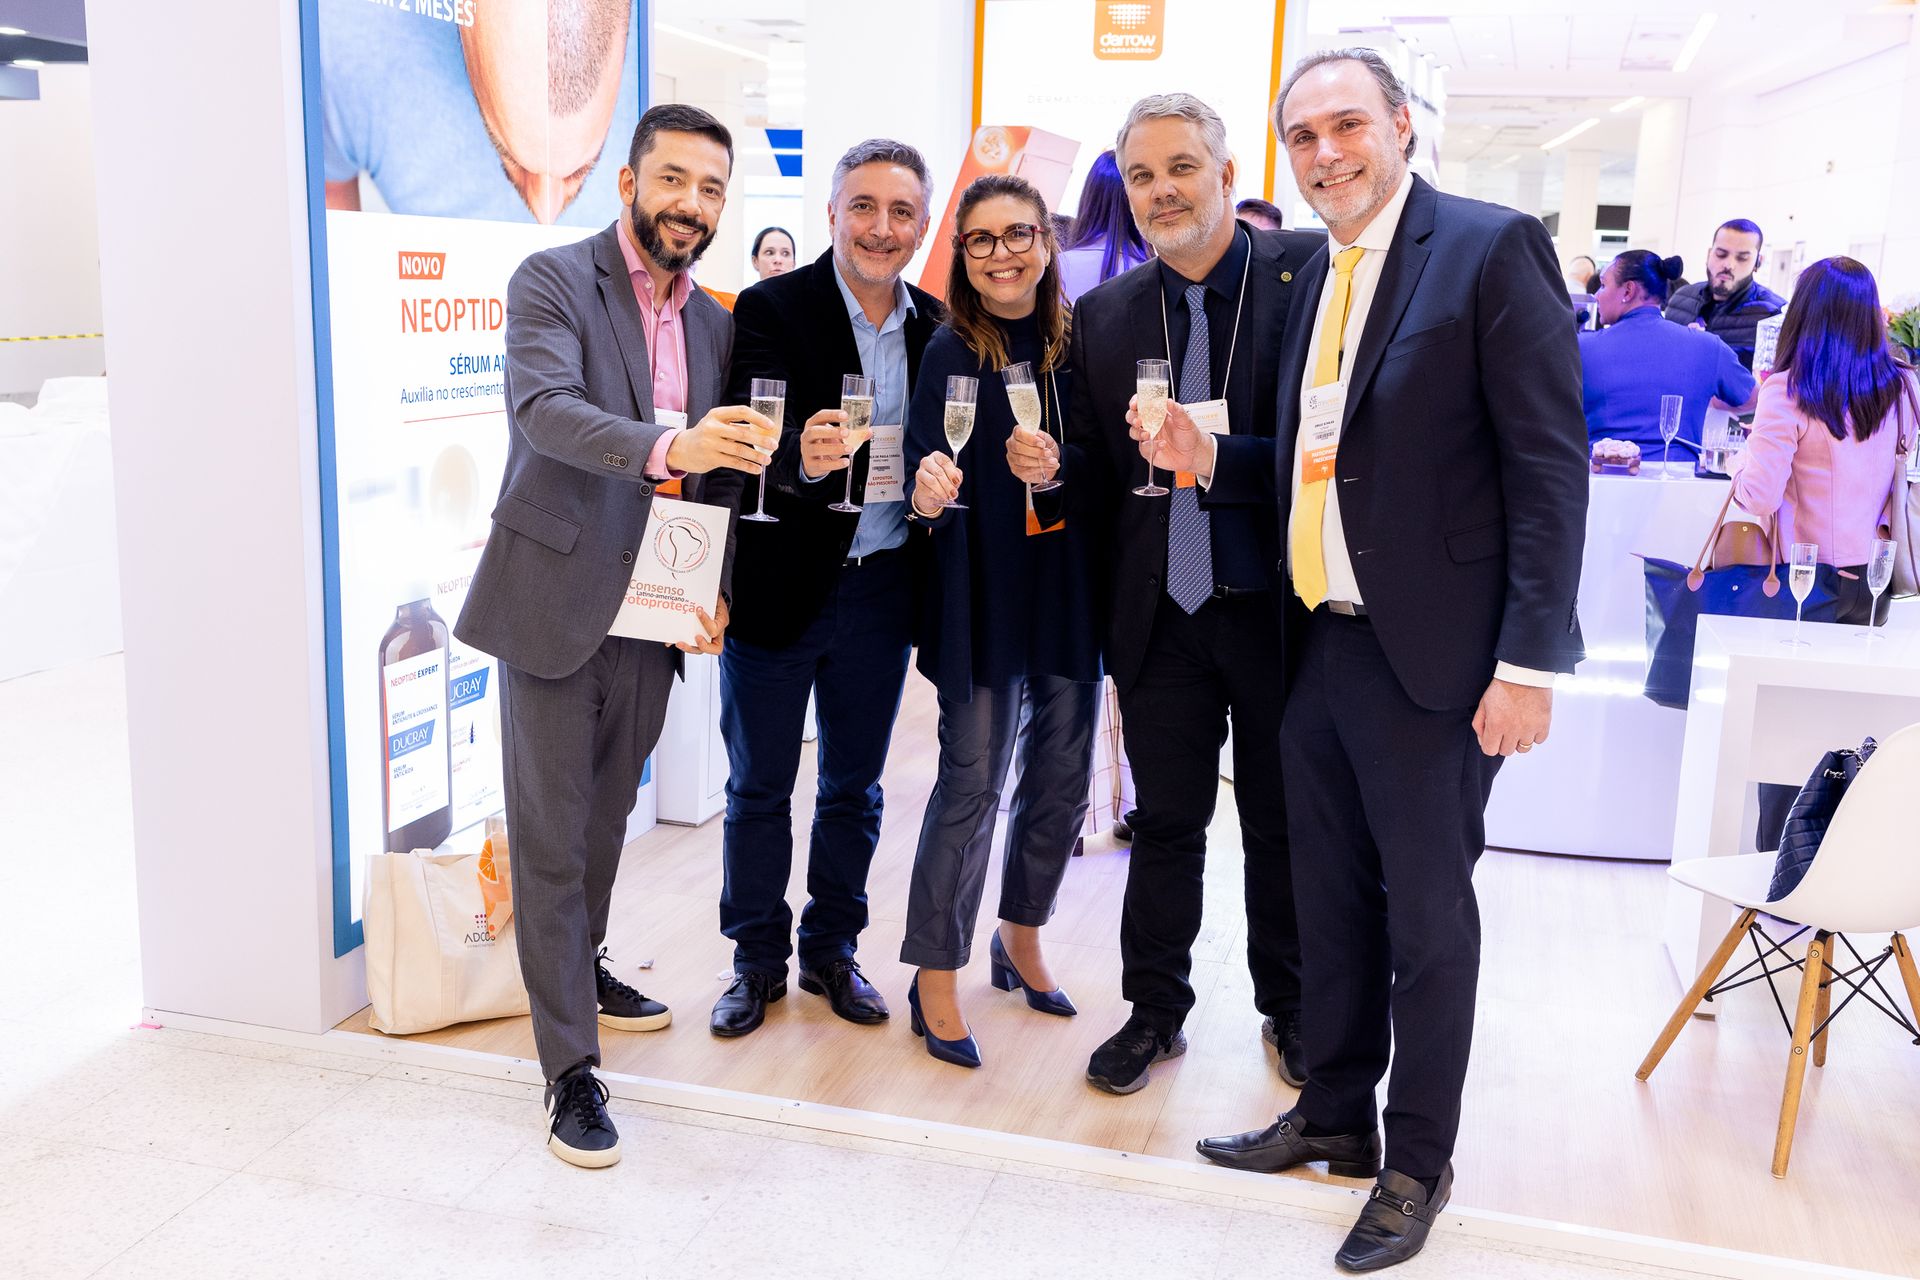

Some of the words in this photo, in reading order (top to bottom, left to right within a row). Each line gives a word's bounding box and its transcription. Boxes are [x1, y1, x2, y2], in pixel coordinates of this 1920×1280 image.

[1100, 32, 1156, 47] darrow
[401, 255, 441, 276] NOVO
[401, 298, 503, 333] NEOPTID
[450, 352, 491, 375] SÉRUM
[400, 386, 434, 404] Auxilia
[436, 389, 448, 401] no
[437, 575, 472, 596] NEOPTID
[629, 579, 685, 597] Consenso
[636, 590, 685, 603] Latino-americano
[390, 671, 417, 688] NEOPTIDE
[417, 664, 439, 679] EXPERT
[450, 675, 482, 701] UCRAY
[393, 726, 429, 752] DUCRAY
